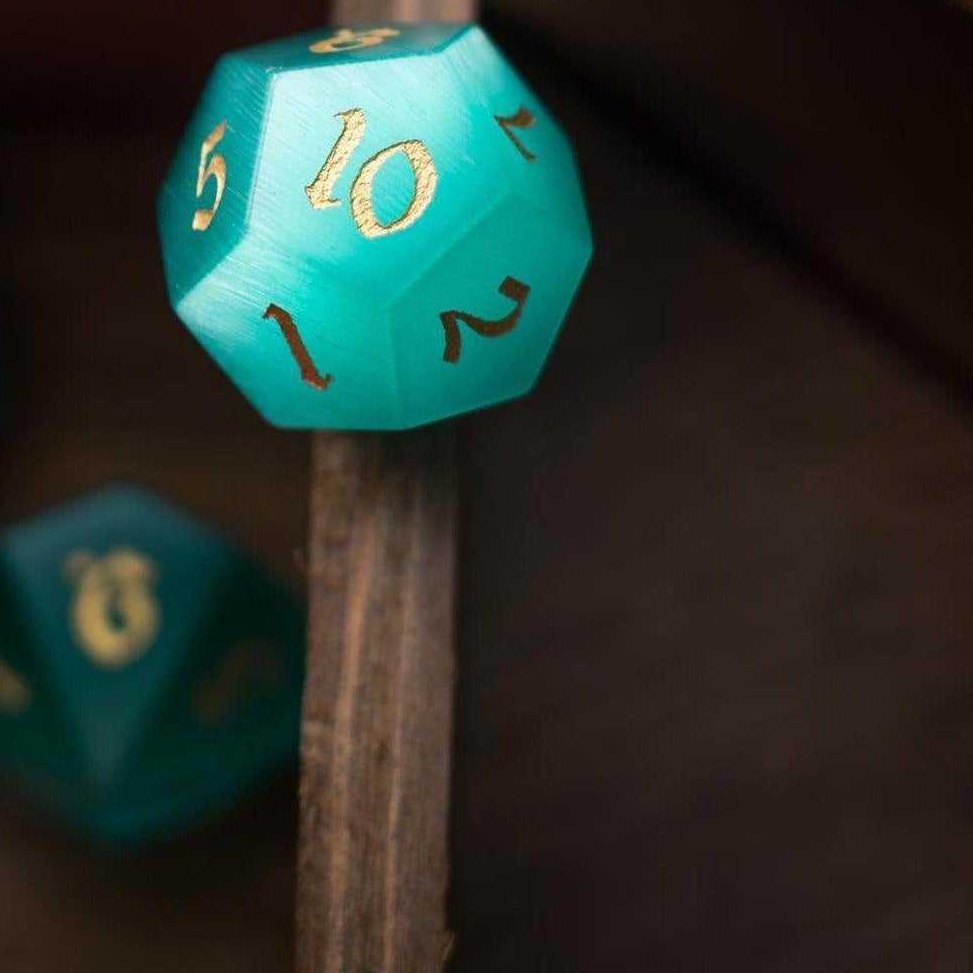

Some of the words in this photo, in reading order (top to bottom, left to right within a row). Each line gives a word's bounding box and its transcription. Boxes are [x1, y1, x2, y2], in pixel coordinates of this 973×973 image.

[192, 119, 230, 231] 5
[304, 108, 439, 240] 10
[262, 303, 334, 391] 1
[439, 275, 530, 364] 2
